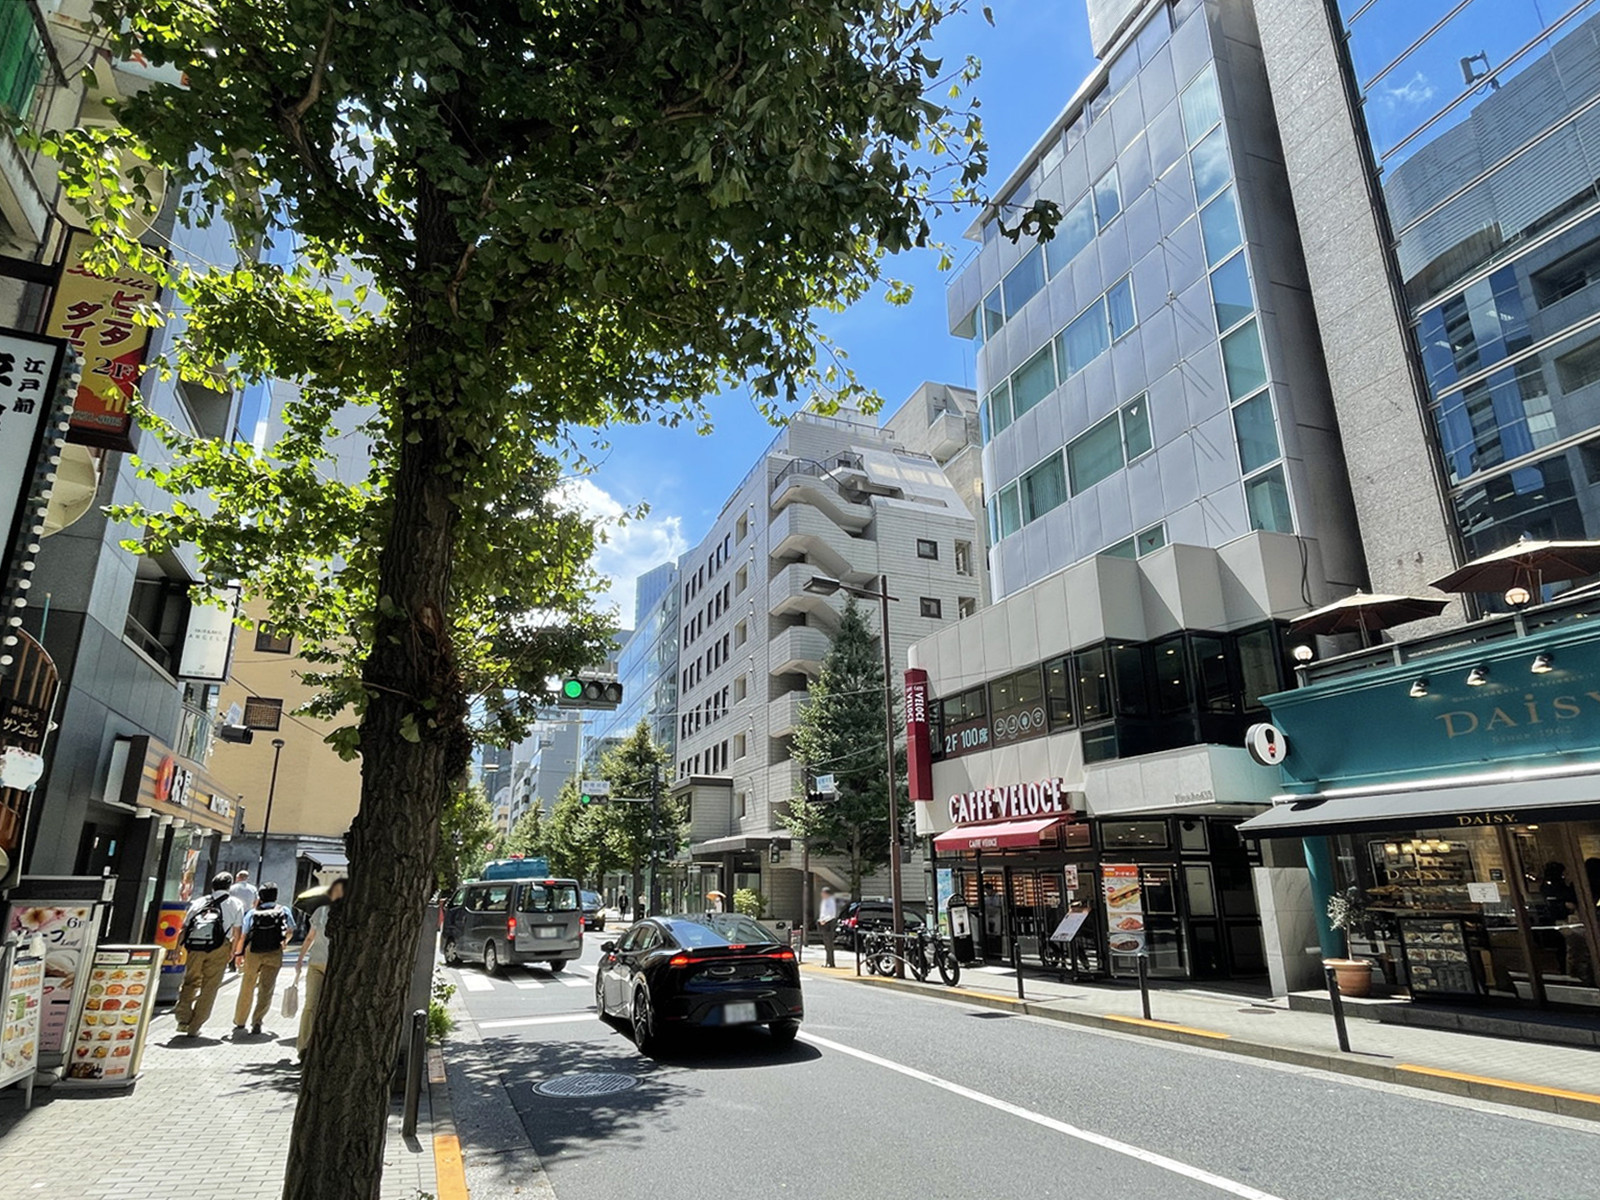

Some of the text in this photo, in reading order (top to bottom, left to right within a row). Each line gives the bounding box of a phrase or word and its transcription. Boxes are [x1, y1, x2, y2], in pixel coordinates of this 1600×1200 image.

[91, 356, 134, 379] 2F
[12, 357, 46, 414] 江戸前
[914, 692, 925, 723] VELOCE
[945, 733, 958, 753] 2F
[996, 778, 1062, 817] VELOCE
